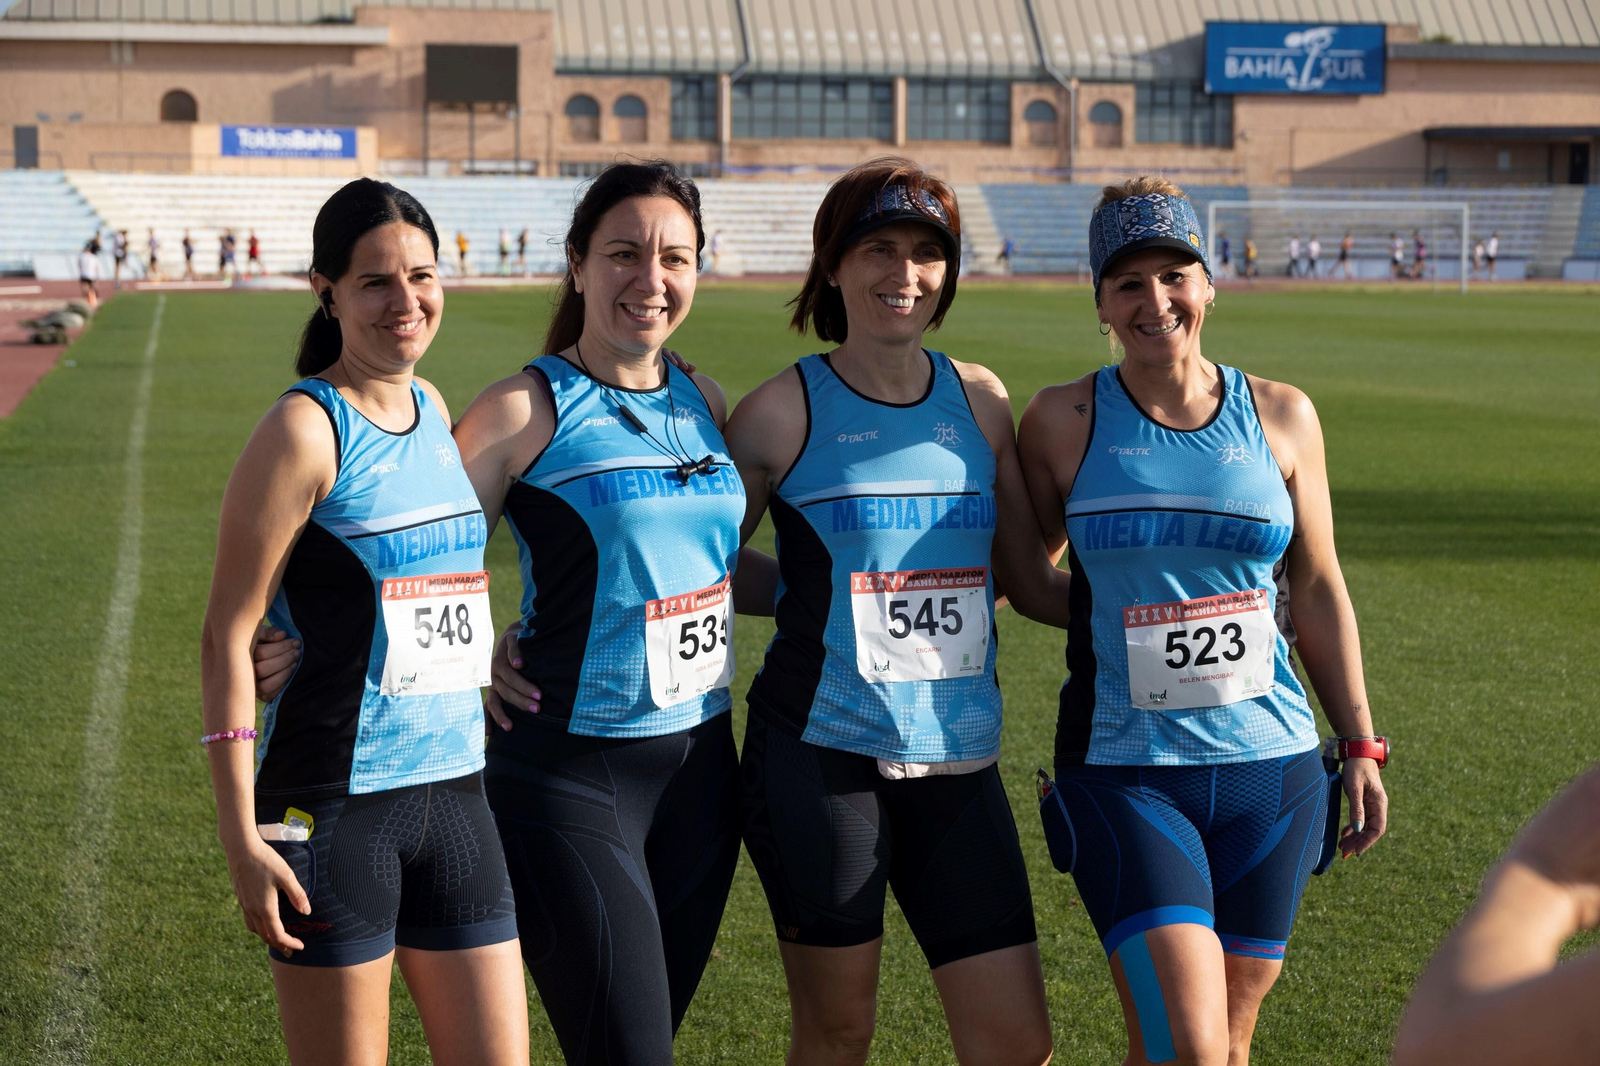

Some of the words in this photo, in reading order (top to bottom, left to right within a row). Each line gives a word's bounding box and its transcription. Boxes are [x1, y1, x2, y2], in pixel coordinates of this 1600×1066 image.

[1225, 53, 1298, 79] BAHÍA
[1320, 58, 1366, 80] SUR
[592, 416, 622, 427] TACTIC
[848, 430, 879, 444] TACTIC
[1118, 447, 1151, 456] TACTIC
[377, 462, 400, 474] TACTIC
[588, 470, 686, 507] MEDIA
[944, 480, 979, 492] BAENA
[832, 498, 922, 533] MEDIA
[1223, 499, 1271, 518] BAENA
[1085, 512, 1185, 550] MEDIA
[378, 521, 449, 569] MEDIA
[429, 577, 453, 586] MEDIA
[906, 578, 939, 588] BAHÍA
[941, 578, 954, 586] DE
[907, 572, 938, 581] MEDIA
[696, 587, 722, 601] MEDIA
[1184, 599, 1215, 611] MEDIA
[1184, 605, 1218, 618] BAHÍA
[1220, 602, 1234, 613] DE
[888, 596, 963, 639] 545
[414, 603, 473, 649] 548
[915, 646, 942, 654] ENCARNI
[1164, 622, 1246, 670] 523
[401, 672, 417, 684] imd
[1178, 676, 1201, 685] BELEN
[1201, 671, 1235, 682] MENGIBAR
[665, 682, 680, 696] imd
[1149, 689, 1168, 701] imd
